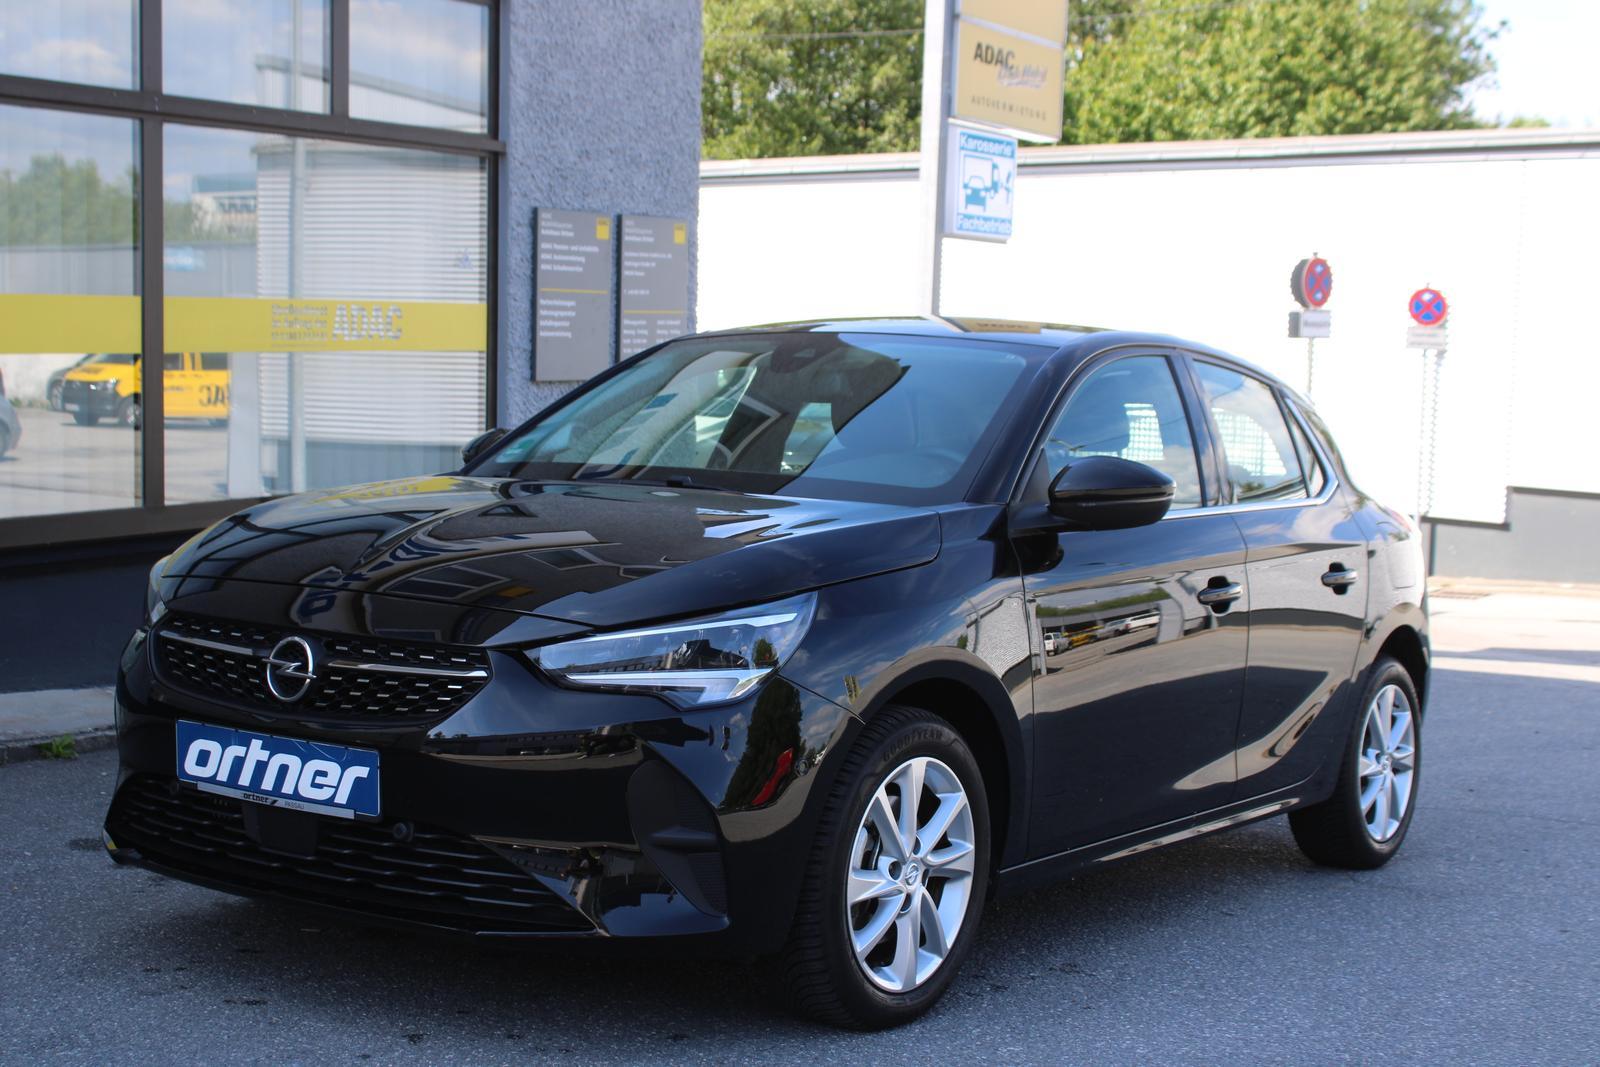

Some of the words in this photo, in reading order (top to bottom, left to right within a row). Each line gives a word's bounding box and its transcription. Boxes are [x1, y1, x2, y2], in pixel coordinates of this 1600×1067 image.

[973, 41, 1015, 70] ADAC
[960, 133, 1012, 156] Karosserie
[958, 214, 1012, 234] Fachbetrieb
[332, 303, 403, 341] ADAC
[882, 729, 943, 763] GOODYEAR
[184, 738, 370, 805] ortner
[243, 792, 269, 804] ortner
